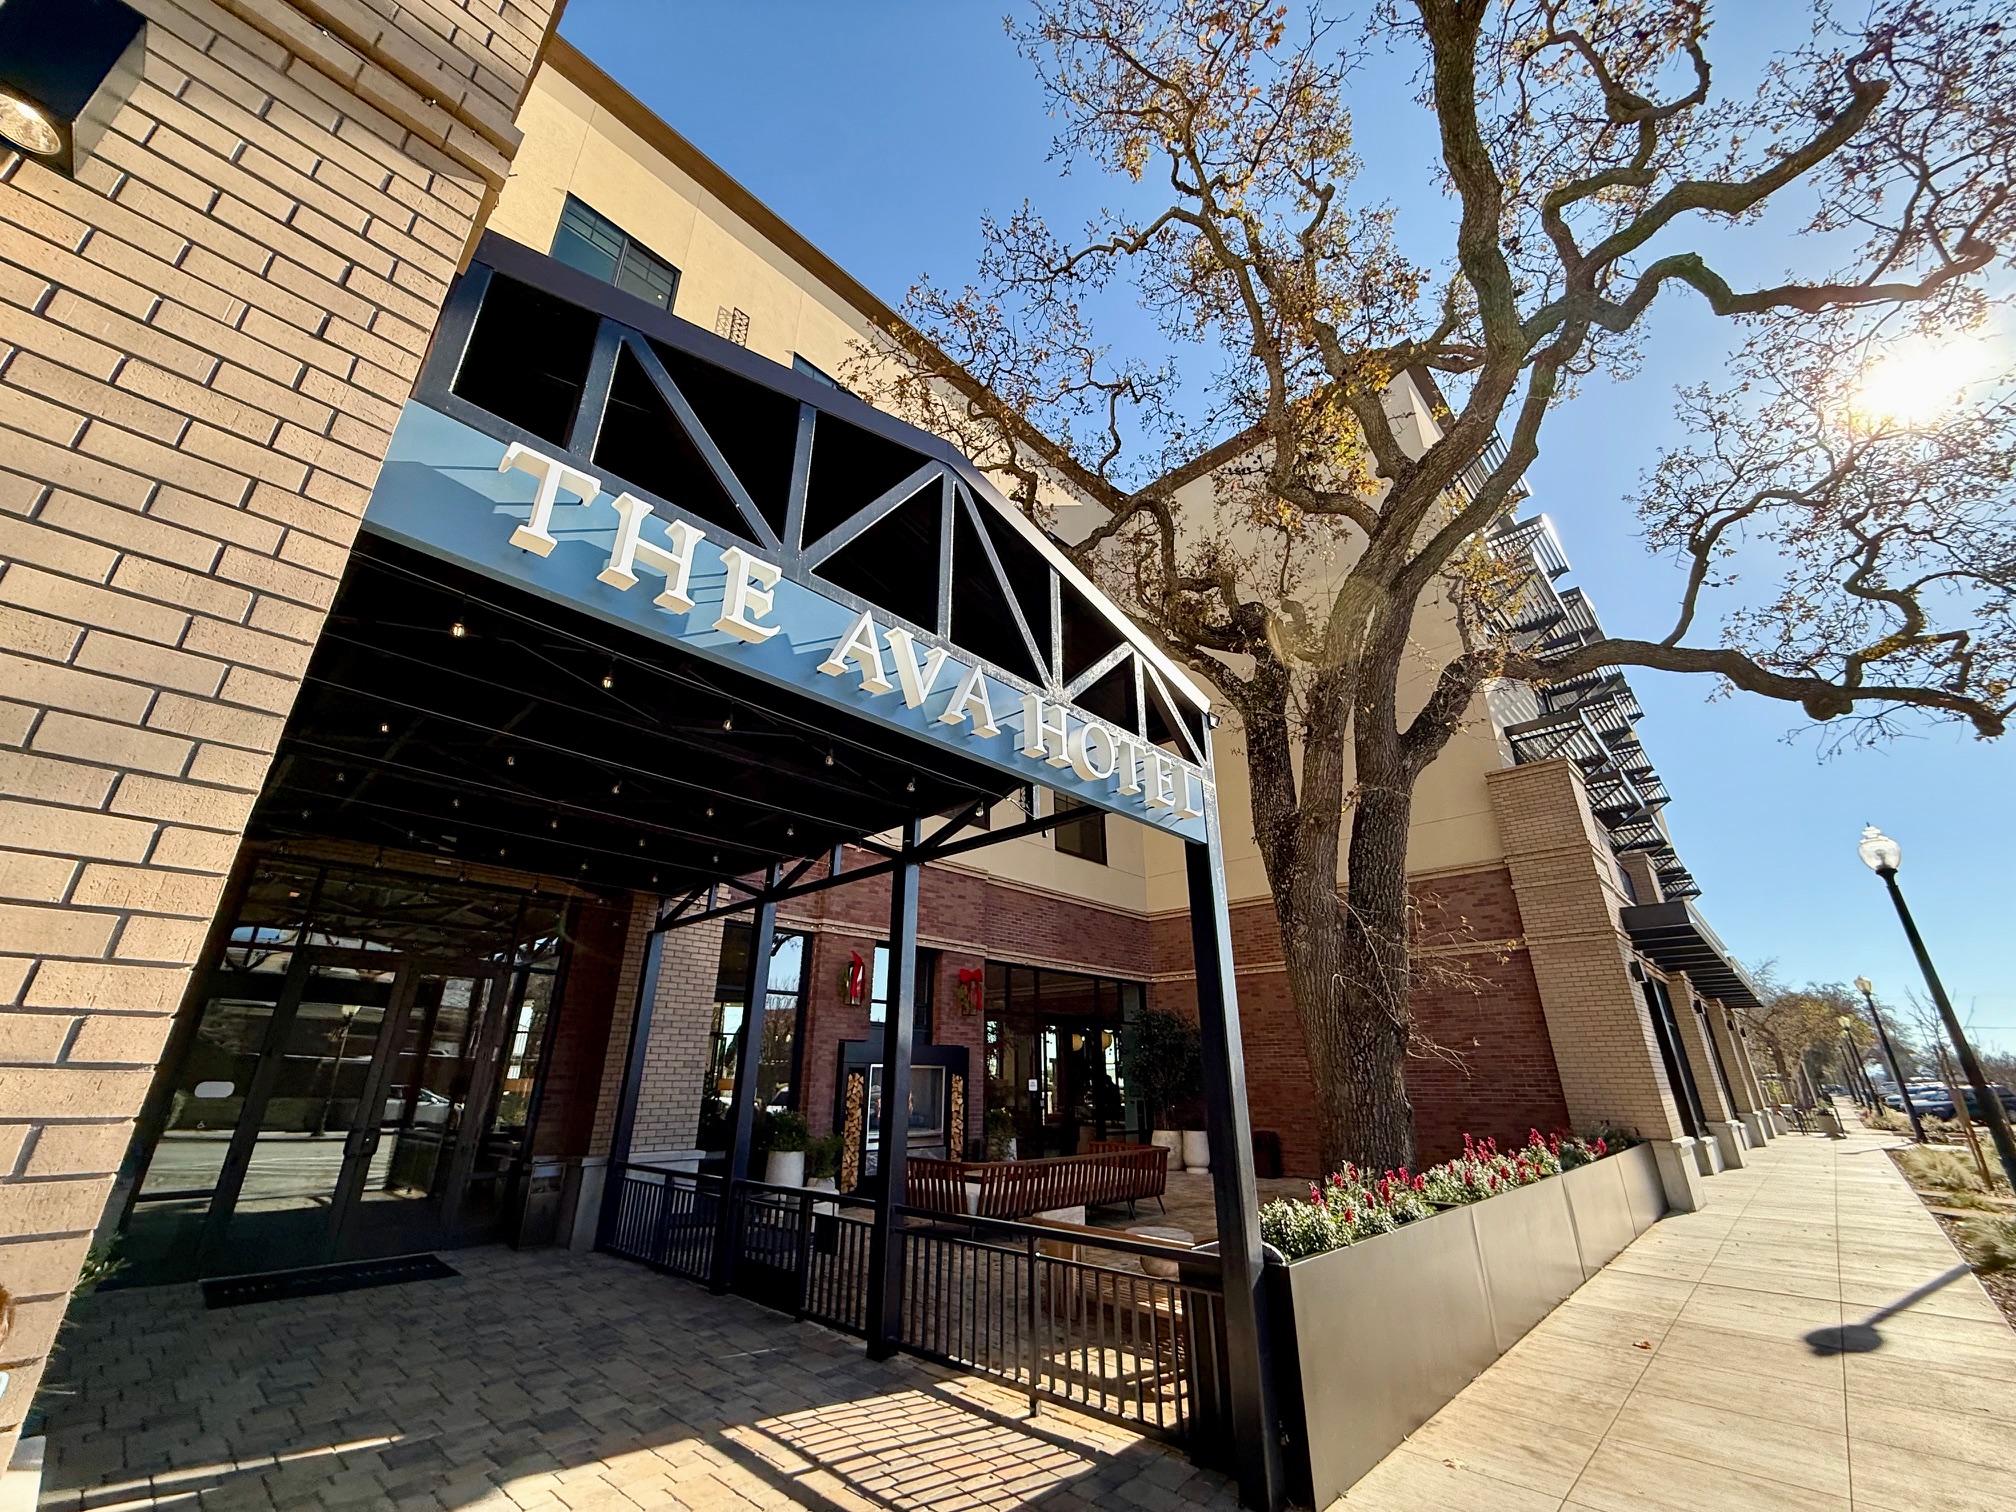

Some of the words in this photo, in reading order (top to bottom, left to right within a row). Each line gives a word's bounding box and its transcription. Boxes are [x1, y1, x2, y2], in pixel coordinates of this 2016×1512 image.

[499, 441, 782, 644] THE
[817, 610, 1001, 739] AVA
[1019, 693, 1203, 819] HOTEL
